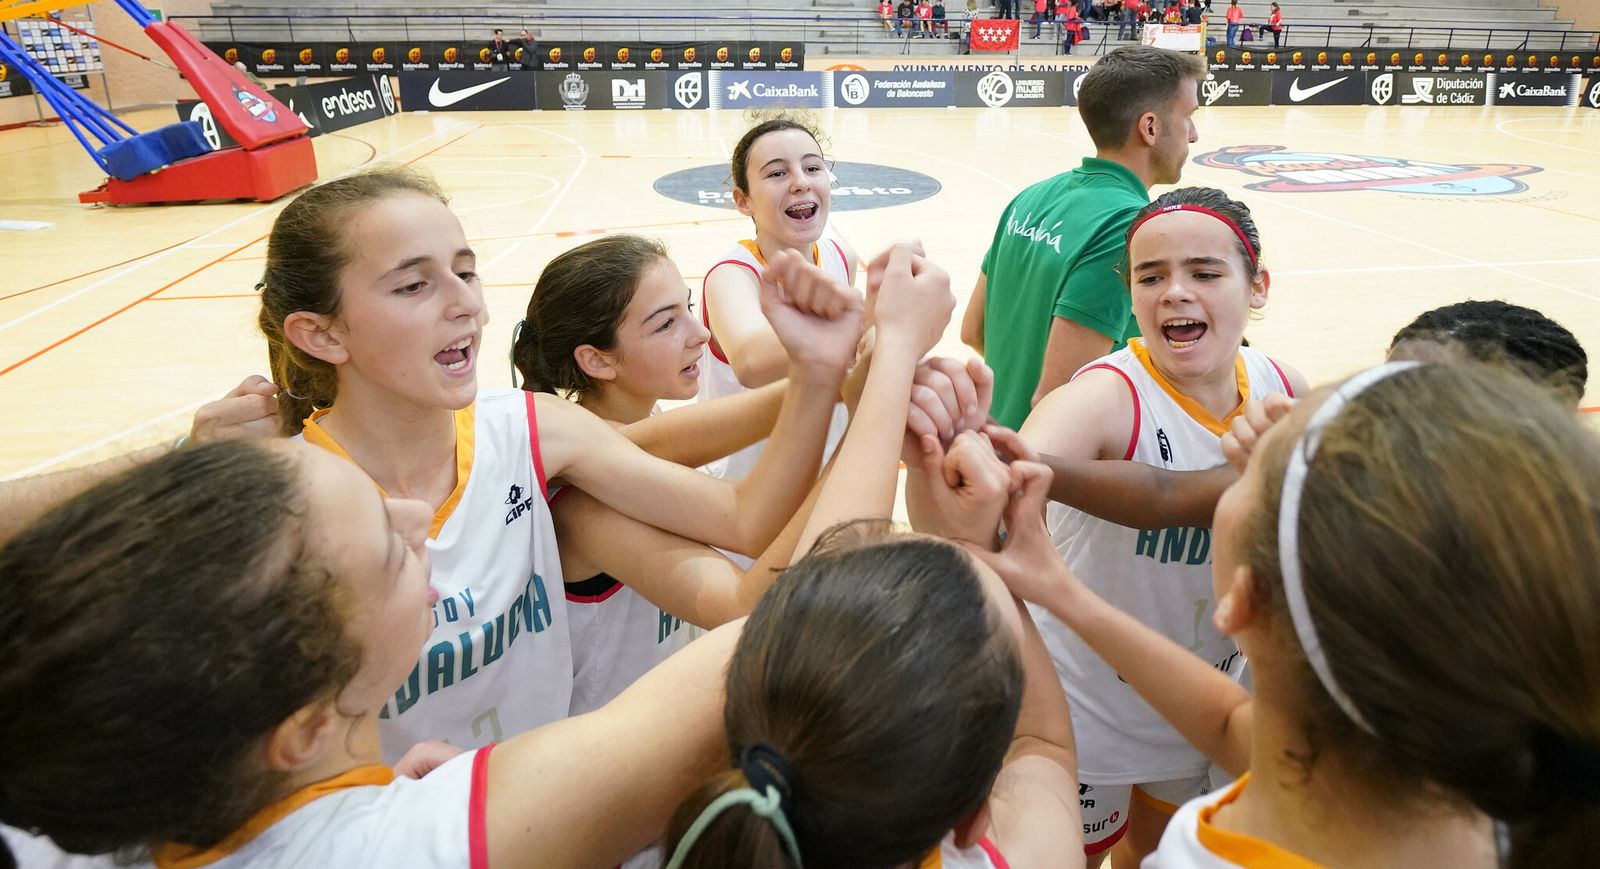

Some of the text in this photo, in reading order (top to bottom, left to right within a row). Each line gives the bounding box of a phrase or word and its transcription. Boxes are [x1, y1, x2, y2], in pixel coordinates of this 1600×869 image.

[753, 83, 818, 97] CaixaBank
[874, 79, 946, 89] Federación Andaluza
[1015, 85, 1045, 94] MUJER
[1436, 77, 1484, 91] Diputación
[886, 89, 934, 98] de Baloncesto
[1516, 84, 1567, 97] CaixaBank
[322, 87, 377, 119] endesa
[1436, 92, 1475, 104] de Cádiz
[1163, 204, 1182, 212] NIKE
[1135, 527, 1212, 566] AND
